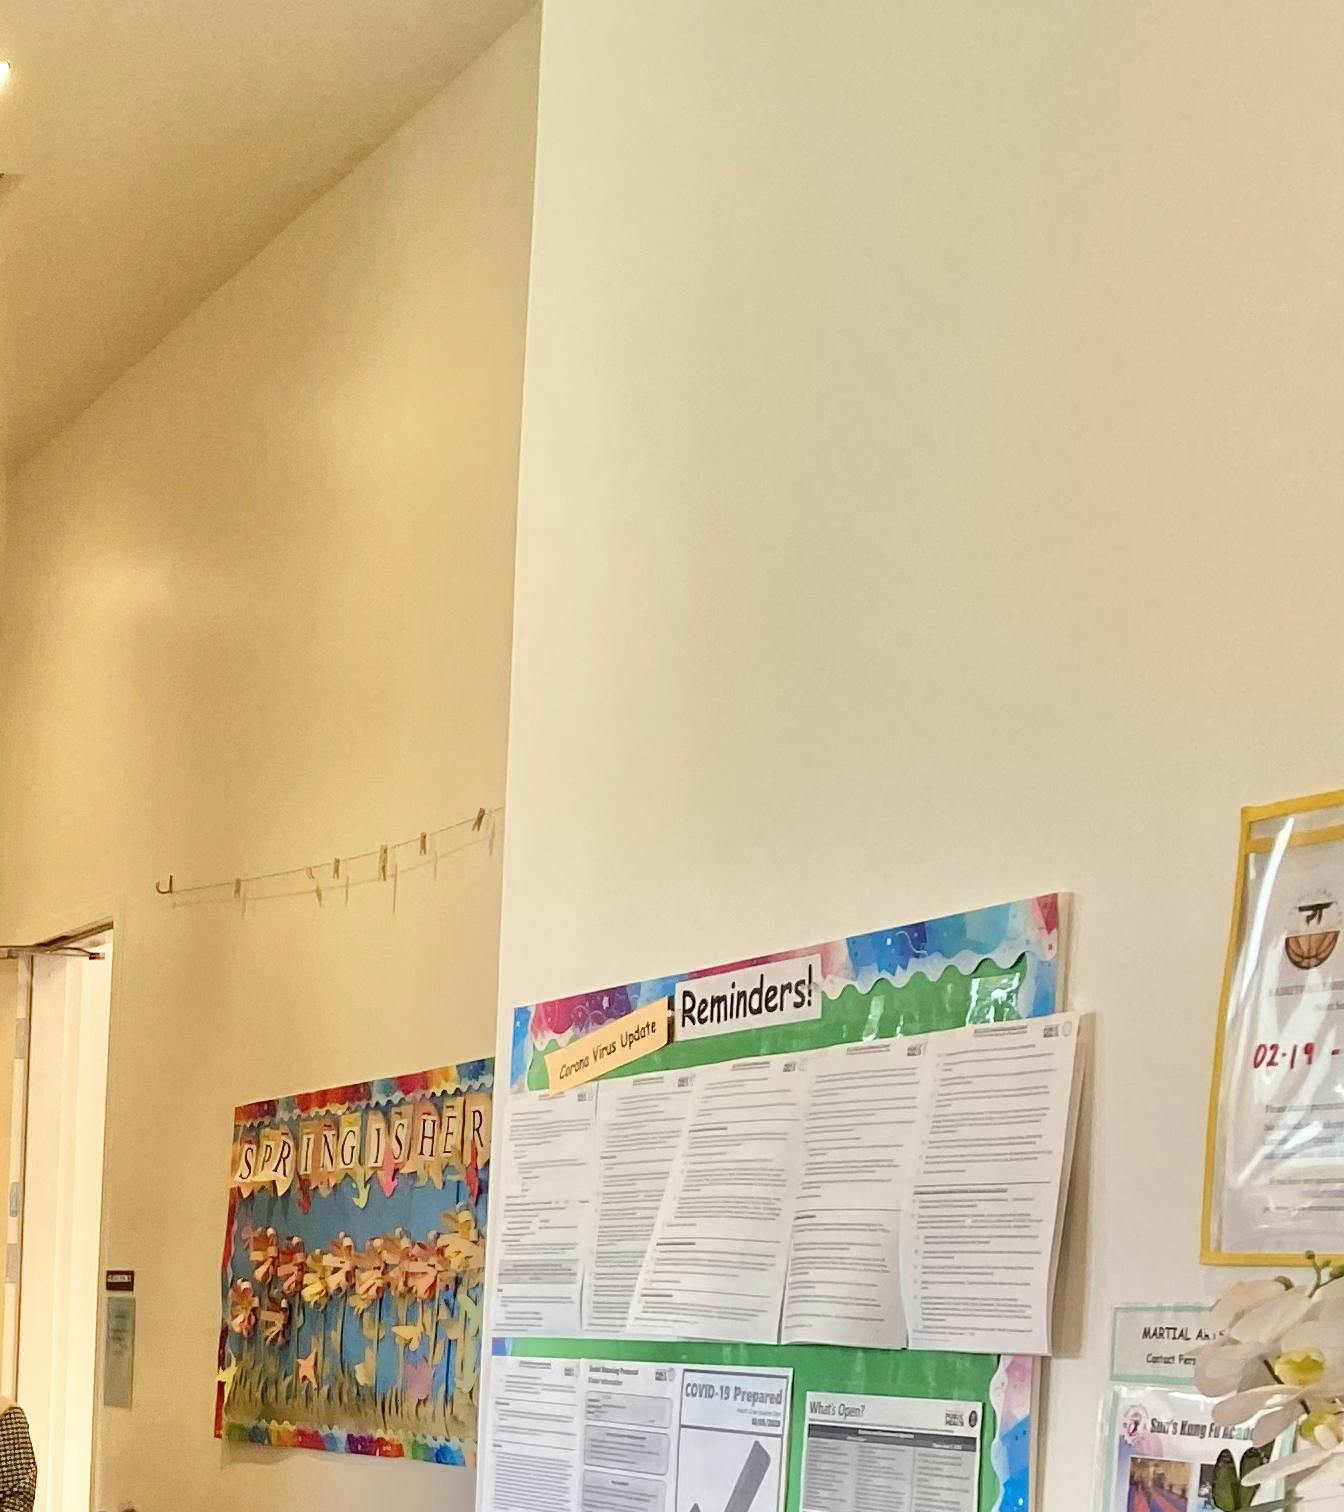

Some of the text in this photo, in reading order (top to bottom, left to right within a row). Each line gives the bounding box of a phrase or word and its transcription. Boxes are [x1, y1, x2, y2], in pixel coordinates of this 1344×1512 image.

[681, 964, 813, 1028] Reminders!
[559, 1020, 657, 1080] Corona Virus Update
[239, 1127, 357, 1180] SPRING
[373, 1121, 408, 1164] IS
[1142, 1326, 1191, 1341] MARTIAL
[685, 1382, 783, 1407] COVID-19 Prepared
[810, 1401, 865, 1418] What's Open?
[1180, 1420, 1206, 1439] Kung
